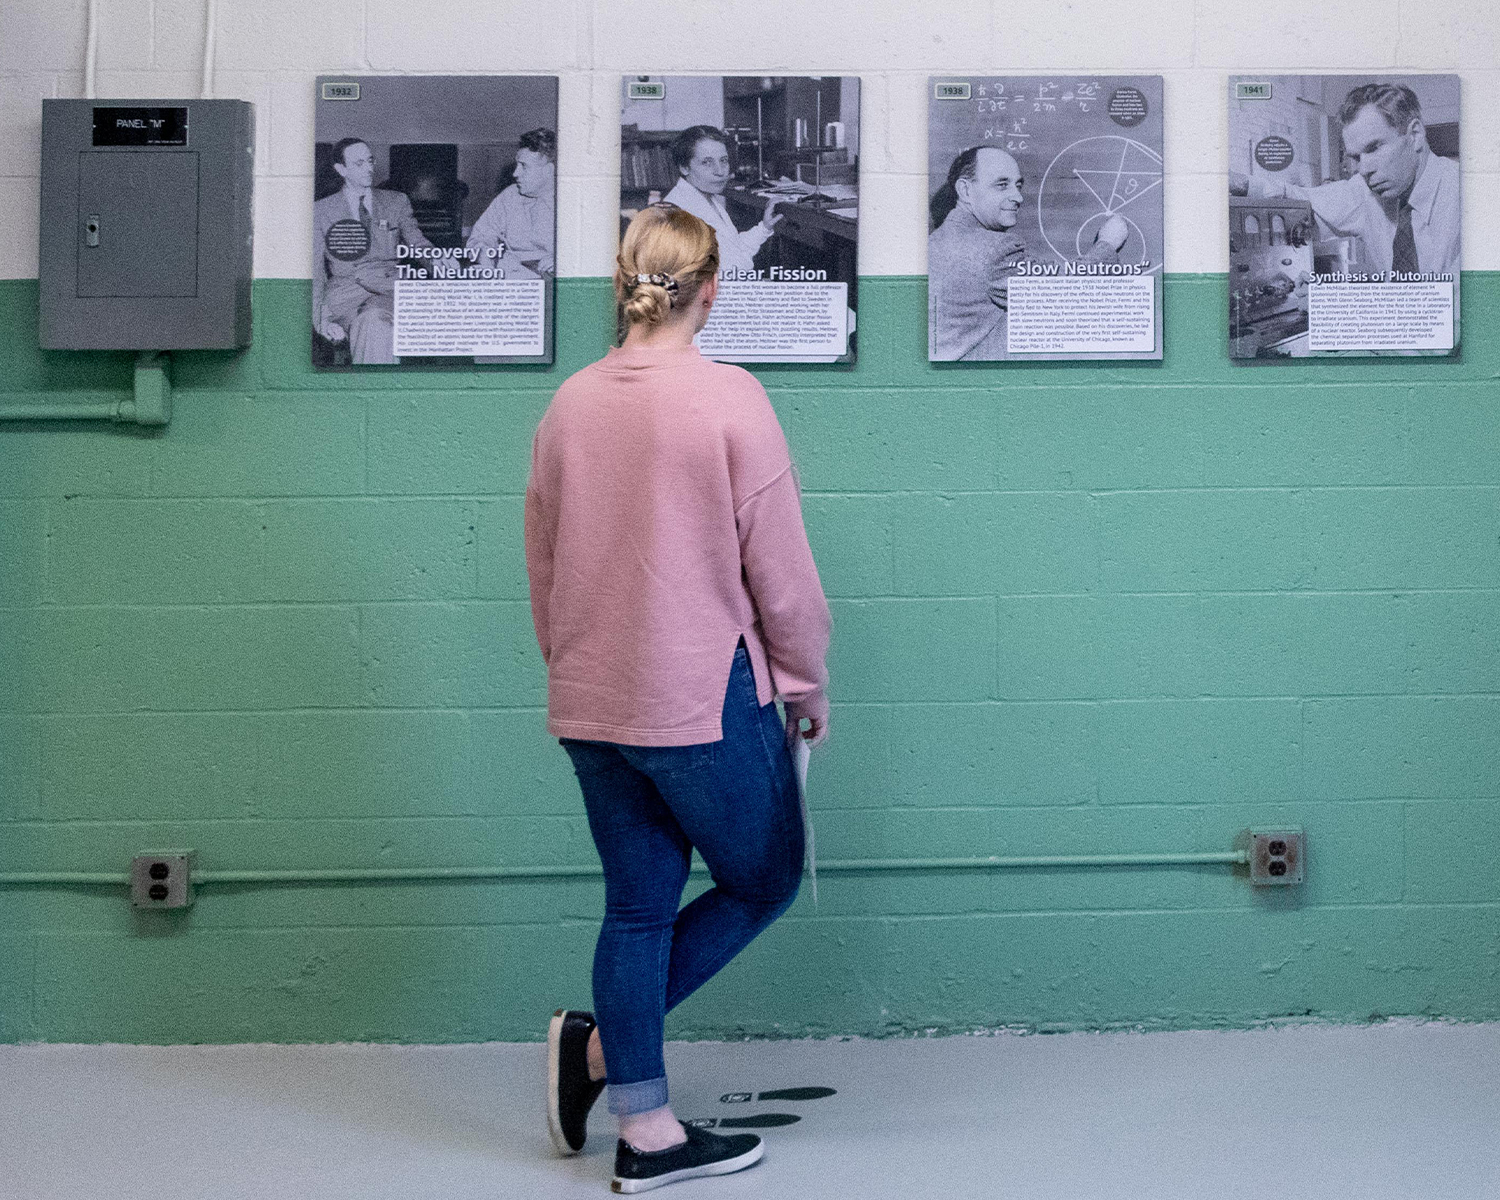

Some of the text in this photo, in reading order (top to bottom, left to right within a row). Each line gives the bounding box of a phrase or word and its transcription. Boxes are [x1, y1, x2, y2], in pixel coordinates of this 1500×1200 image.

[330, 87, 352, 96] 1932
[636, 86, 657, 95] 1938
[943, 86, 964, 95] 1938
[1244, 85, 1264, 94] 1941
[116, 119, 147, 128] PANEL
[396, 243, 504, 262] Discovery of
[396, 264, 504, 279] The Neutron
[770, 266, 828, 281] Fission
[1309, 271, 1453, 285] Synthesis of Plutonium
